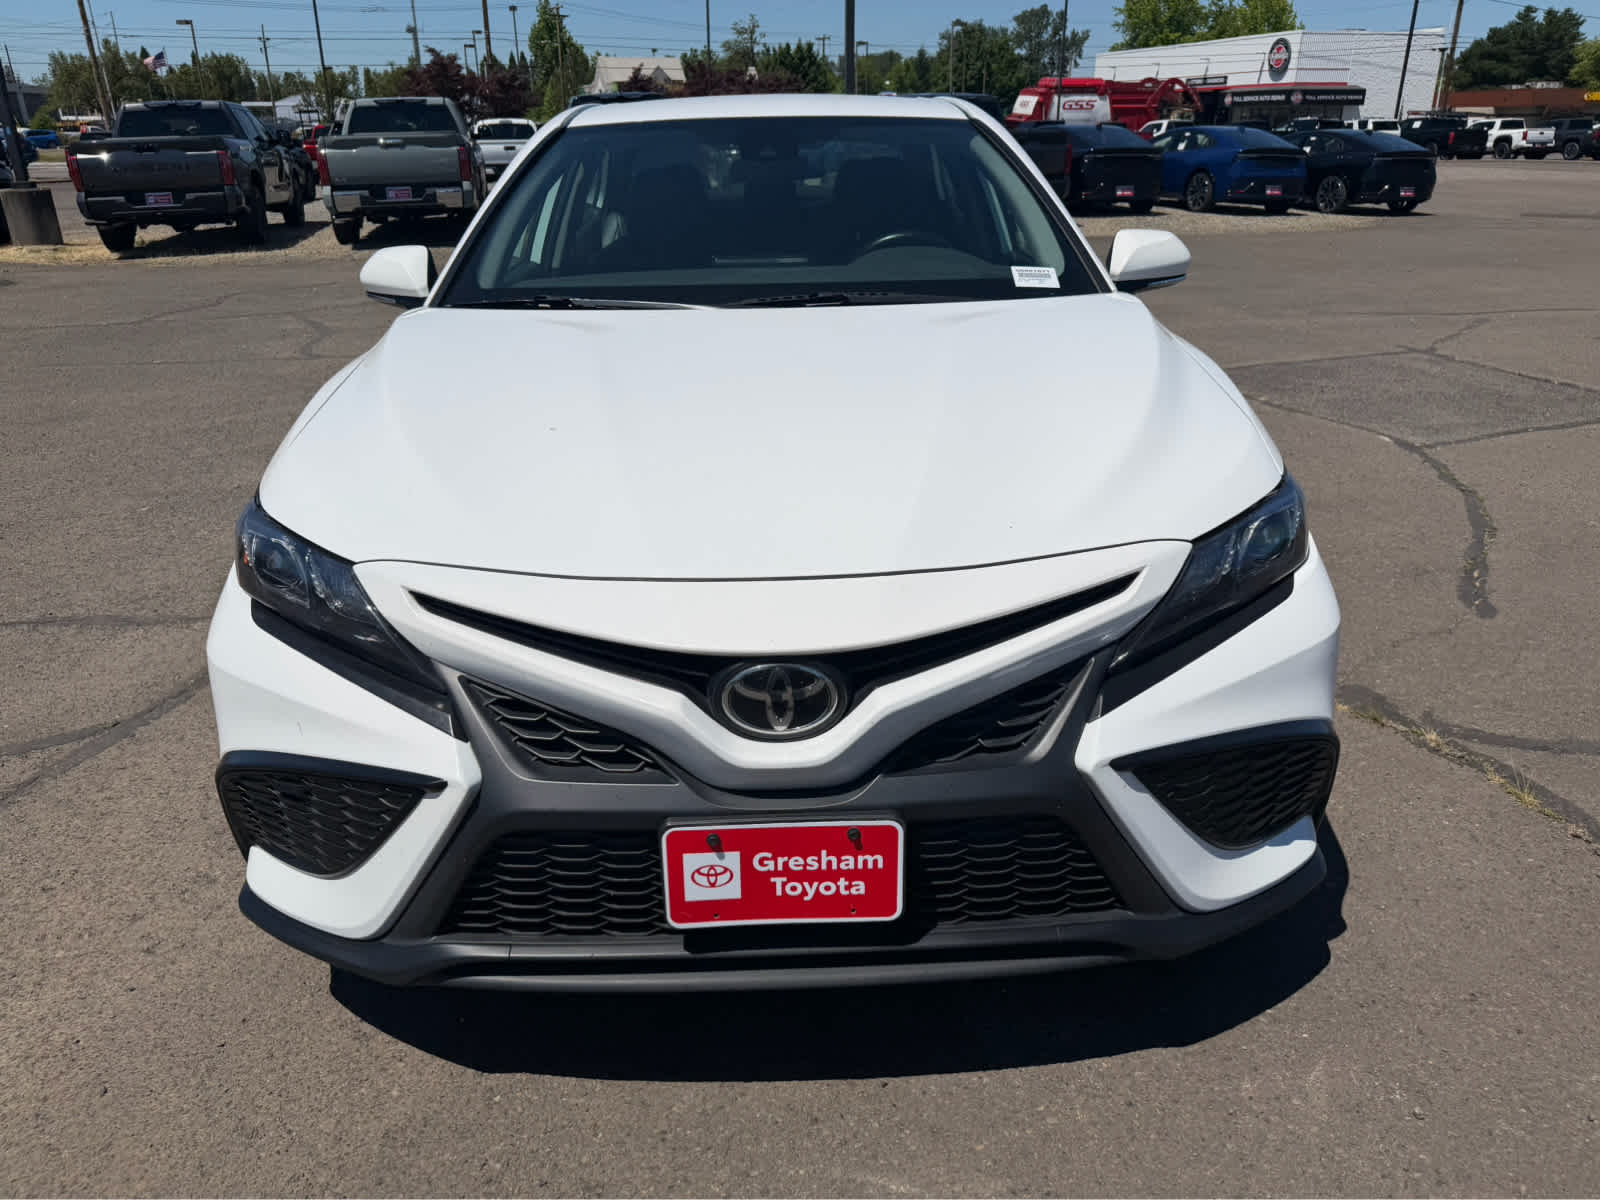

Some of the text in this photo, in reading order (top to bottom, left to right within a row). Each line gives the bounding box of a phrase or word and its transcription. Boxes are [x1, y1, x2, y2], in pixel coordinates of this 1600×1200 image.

[1063, 99, 1097, 111] GSS
[752, 849, 884, 872] Gresham
[770, 876, 866, 901] Toyota
